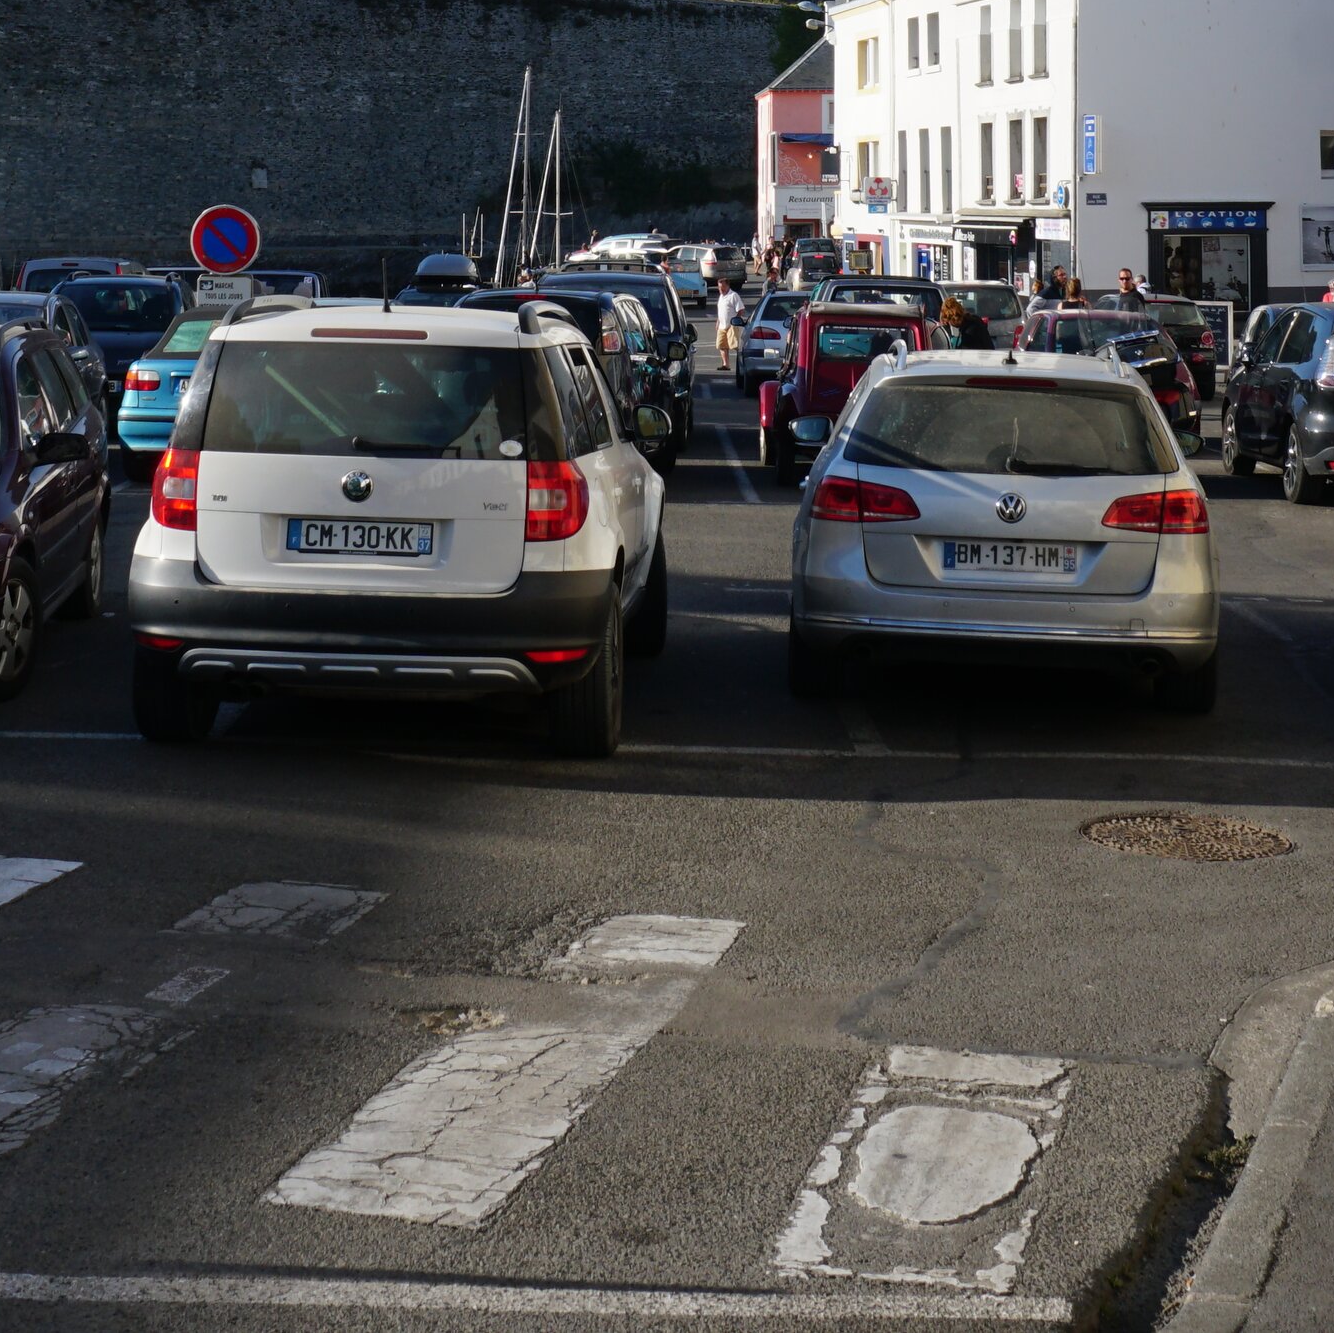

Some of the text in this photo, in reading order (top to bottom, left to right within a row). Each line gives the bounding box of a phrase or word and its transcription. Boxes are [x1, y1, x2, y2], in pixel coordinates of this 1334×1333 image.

[788, 195, 834, 203] Restaurant
[1174, 210, 1257, 218] LOCATION
[305, 524, 414, 550] CM-130-KK
[418, 539, 430, 551] 37
[957, 543, 1059, 567] BM-137-HM
[1064, 559, 1075, 570] 95
